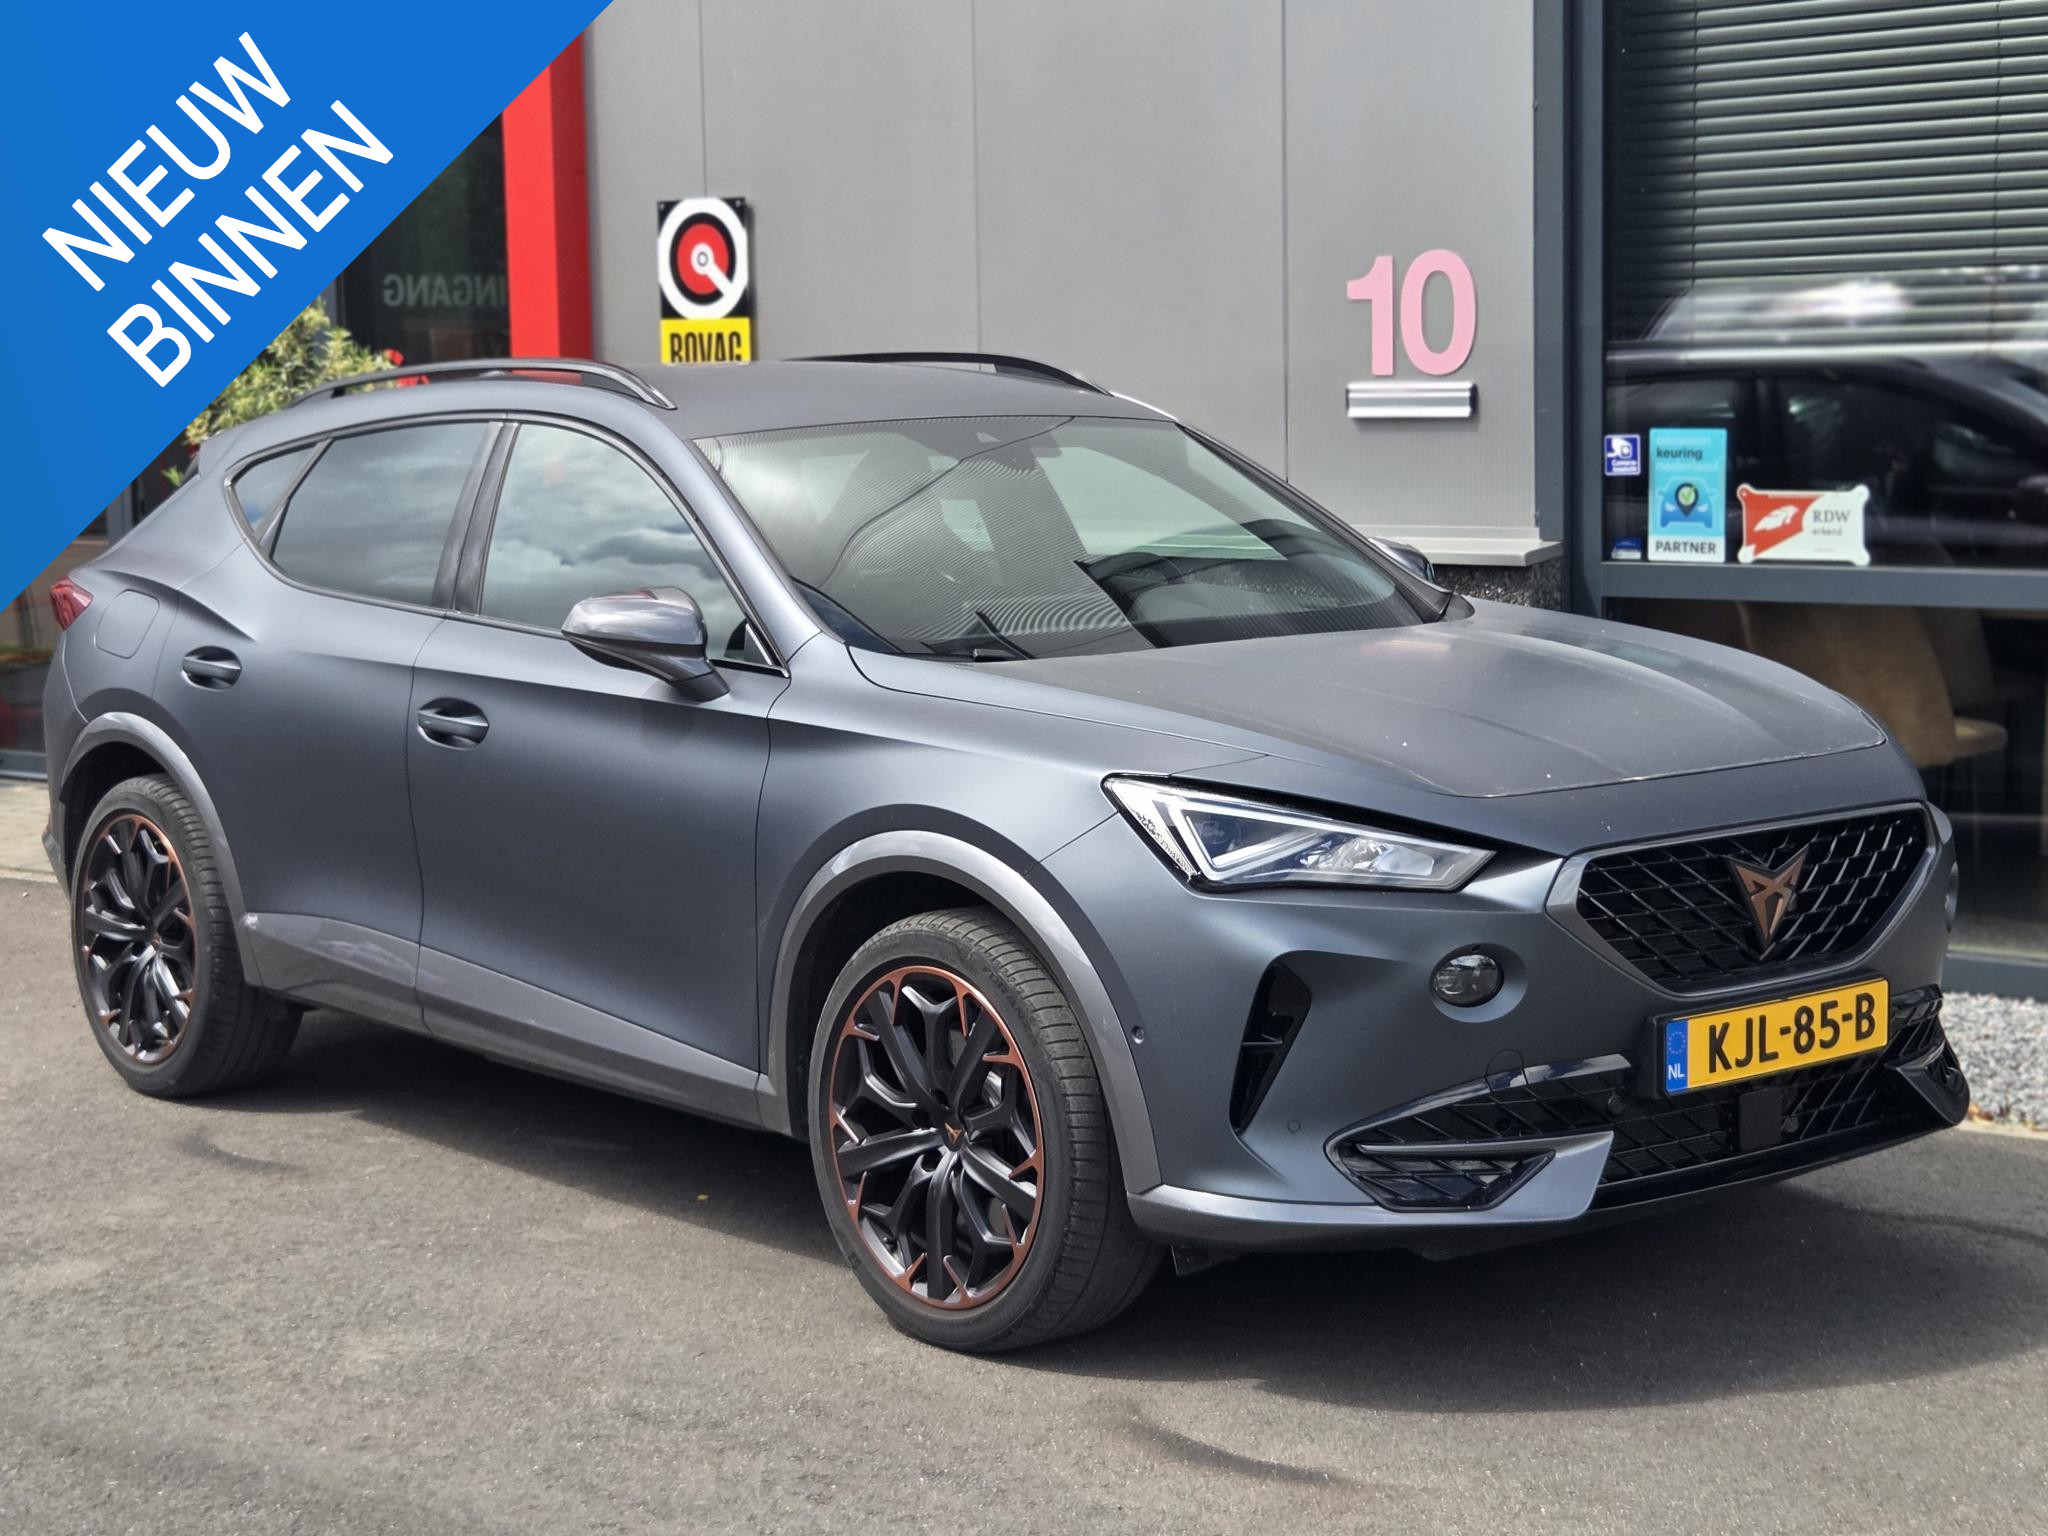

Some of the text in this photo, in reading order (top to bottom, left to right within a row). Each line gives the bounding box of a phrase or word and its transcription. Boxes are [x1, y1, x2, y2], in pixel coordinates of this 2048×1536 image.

[1346, 249, 1477, 376] 10
[1656, 445, 1703, 461] keuring
[1812, 510, 1851, 523] RDW
[1655, 540, 1717, 555] PARTNER
[1708, 992, 1876, 1074] KJL-85-B
[1668, 1062, 1685, 1081] NL
